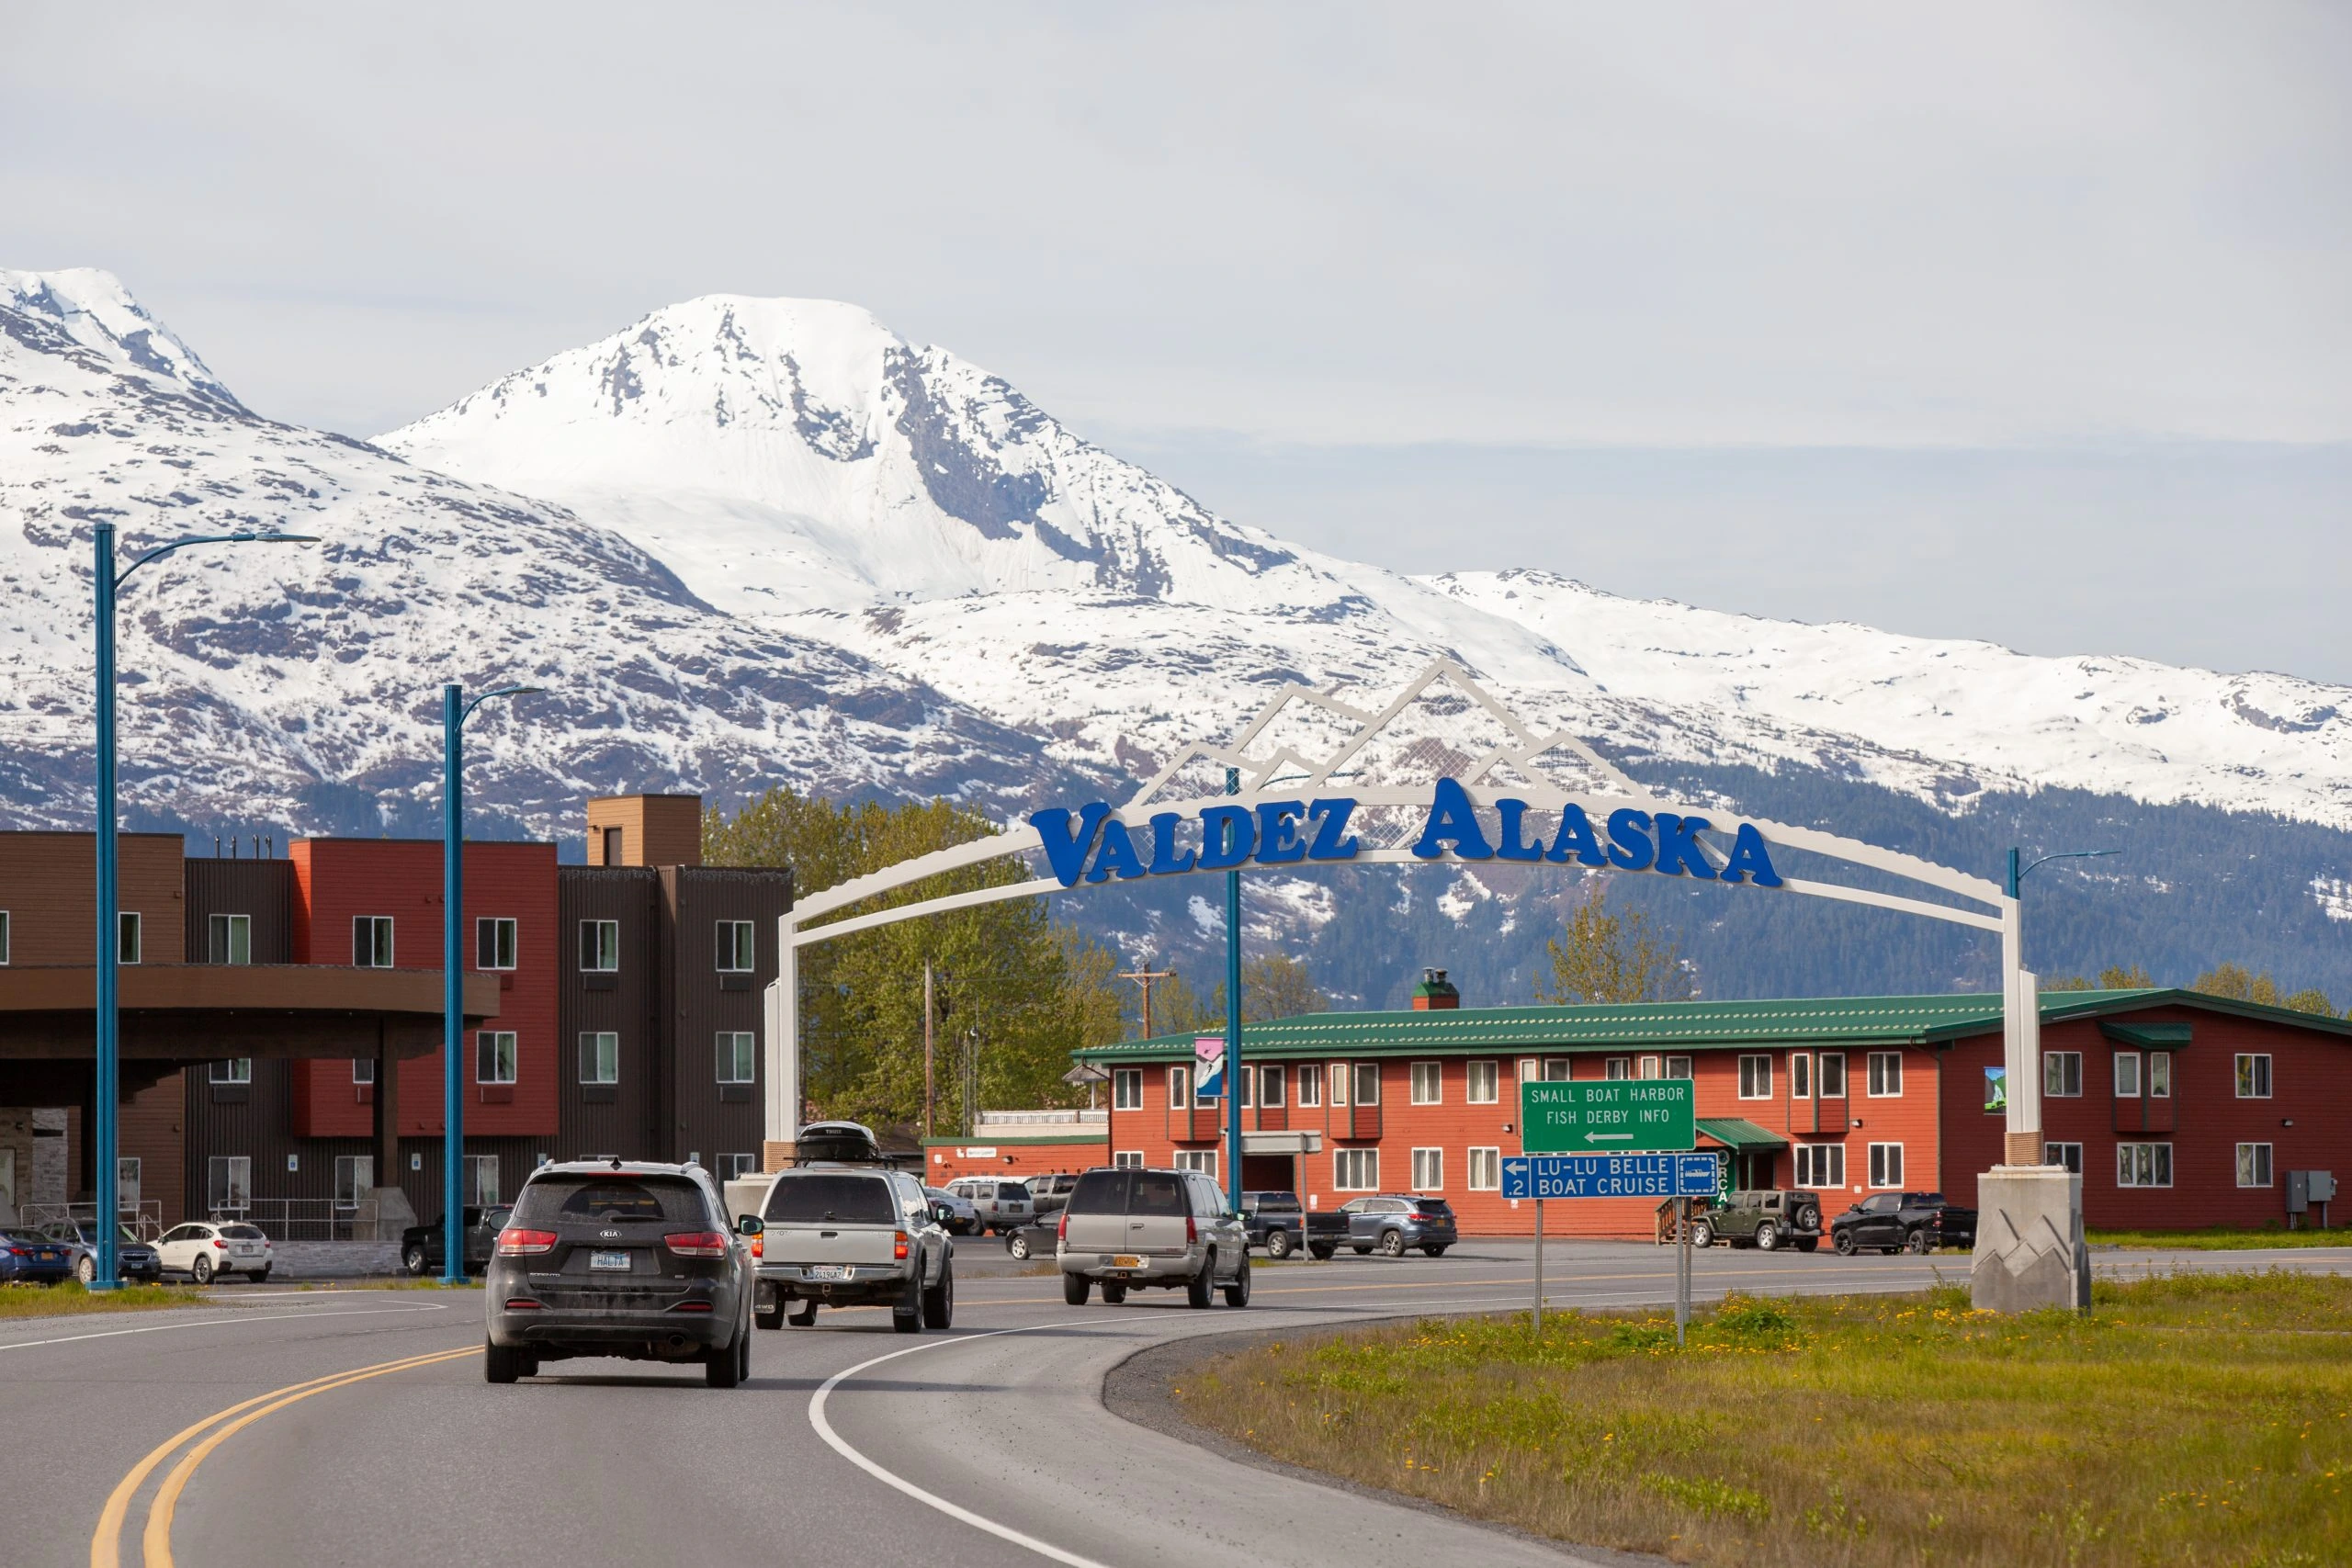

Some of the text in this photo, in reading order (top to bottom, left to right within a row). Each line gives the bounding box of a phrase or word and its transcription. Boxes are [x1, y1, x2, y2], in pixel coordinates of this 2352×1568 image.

[1029, 777, 1783, 888] VALDEZ ALASKA
[1532, 1088, 1684, 1103] SMALL BOAT HARBOR
[1547, 1109, 1669, 1124] FISH DERBY INFO
[1538, 1157, 1668, 1176] LU-LU BELLE
[1509, 1179, 1523, 1196] .2
[1539, 1178, 1668, 1195] BOAT CRUISE
